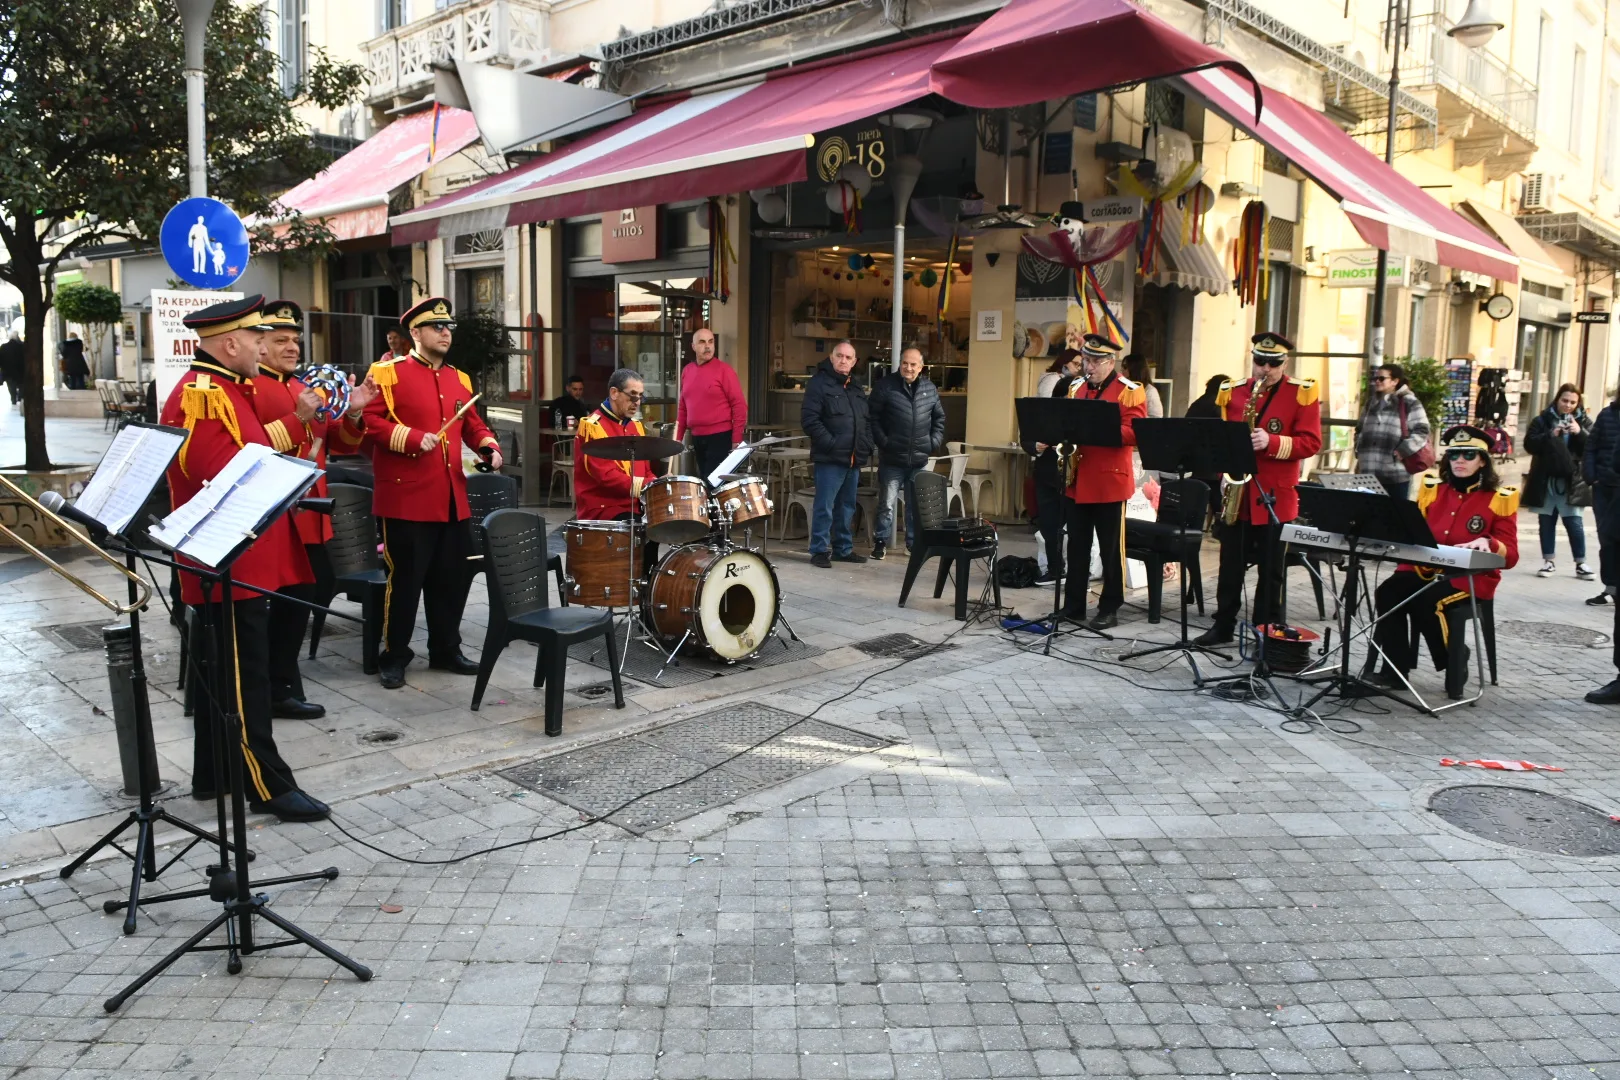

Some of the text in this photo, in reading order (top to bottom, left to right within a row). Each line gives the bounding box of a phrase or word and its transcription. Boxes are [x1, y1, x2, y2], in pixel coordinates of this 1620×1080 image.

[157, 296, 169, 306] ΤΑ
[171, 297, 208, 306] ΚΕΡΔΗ
[168, 309, 180, 318] ΟΙ
[1294, 529, 1330, 544] Roland
